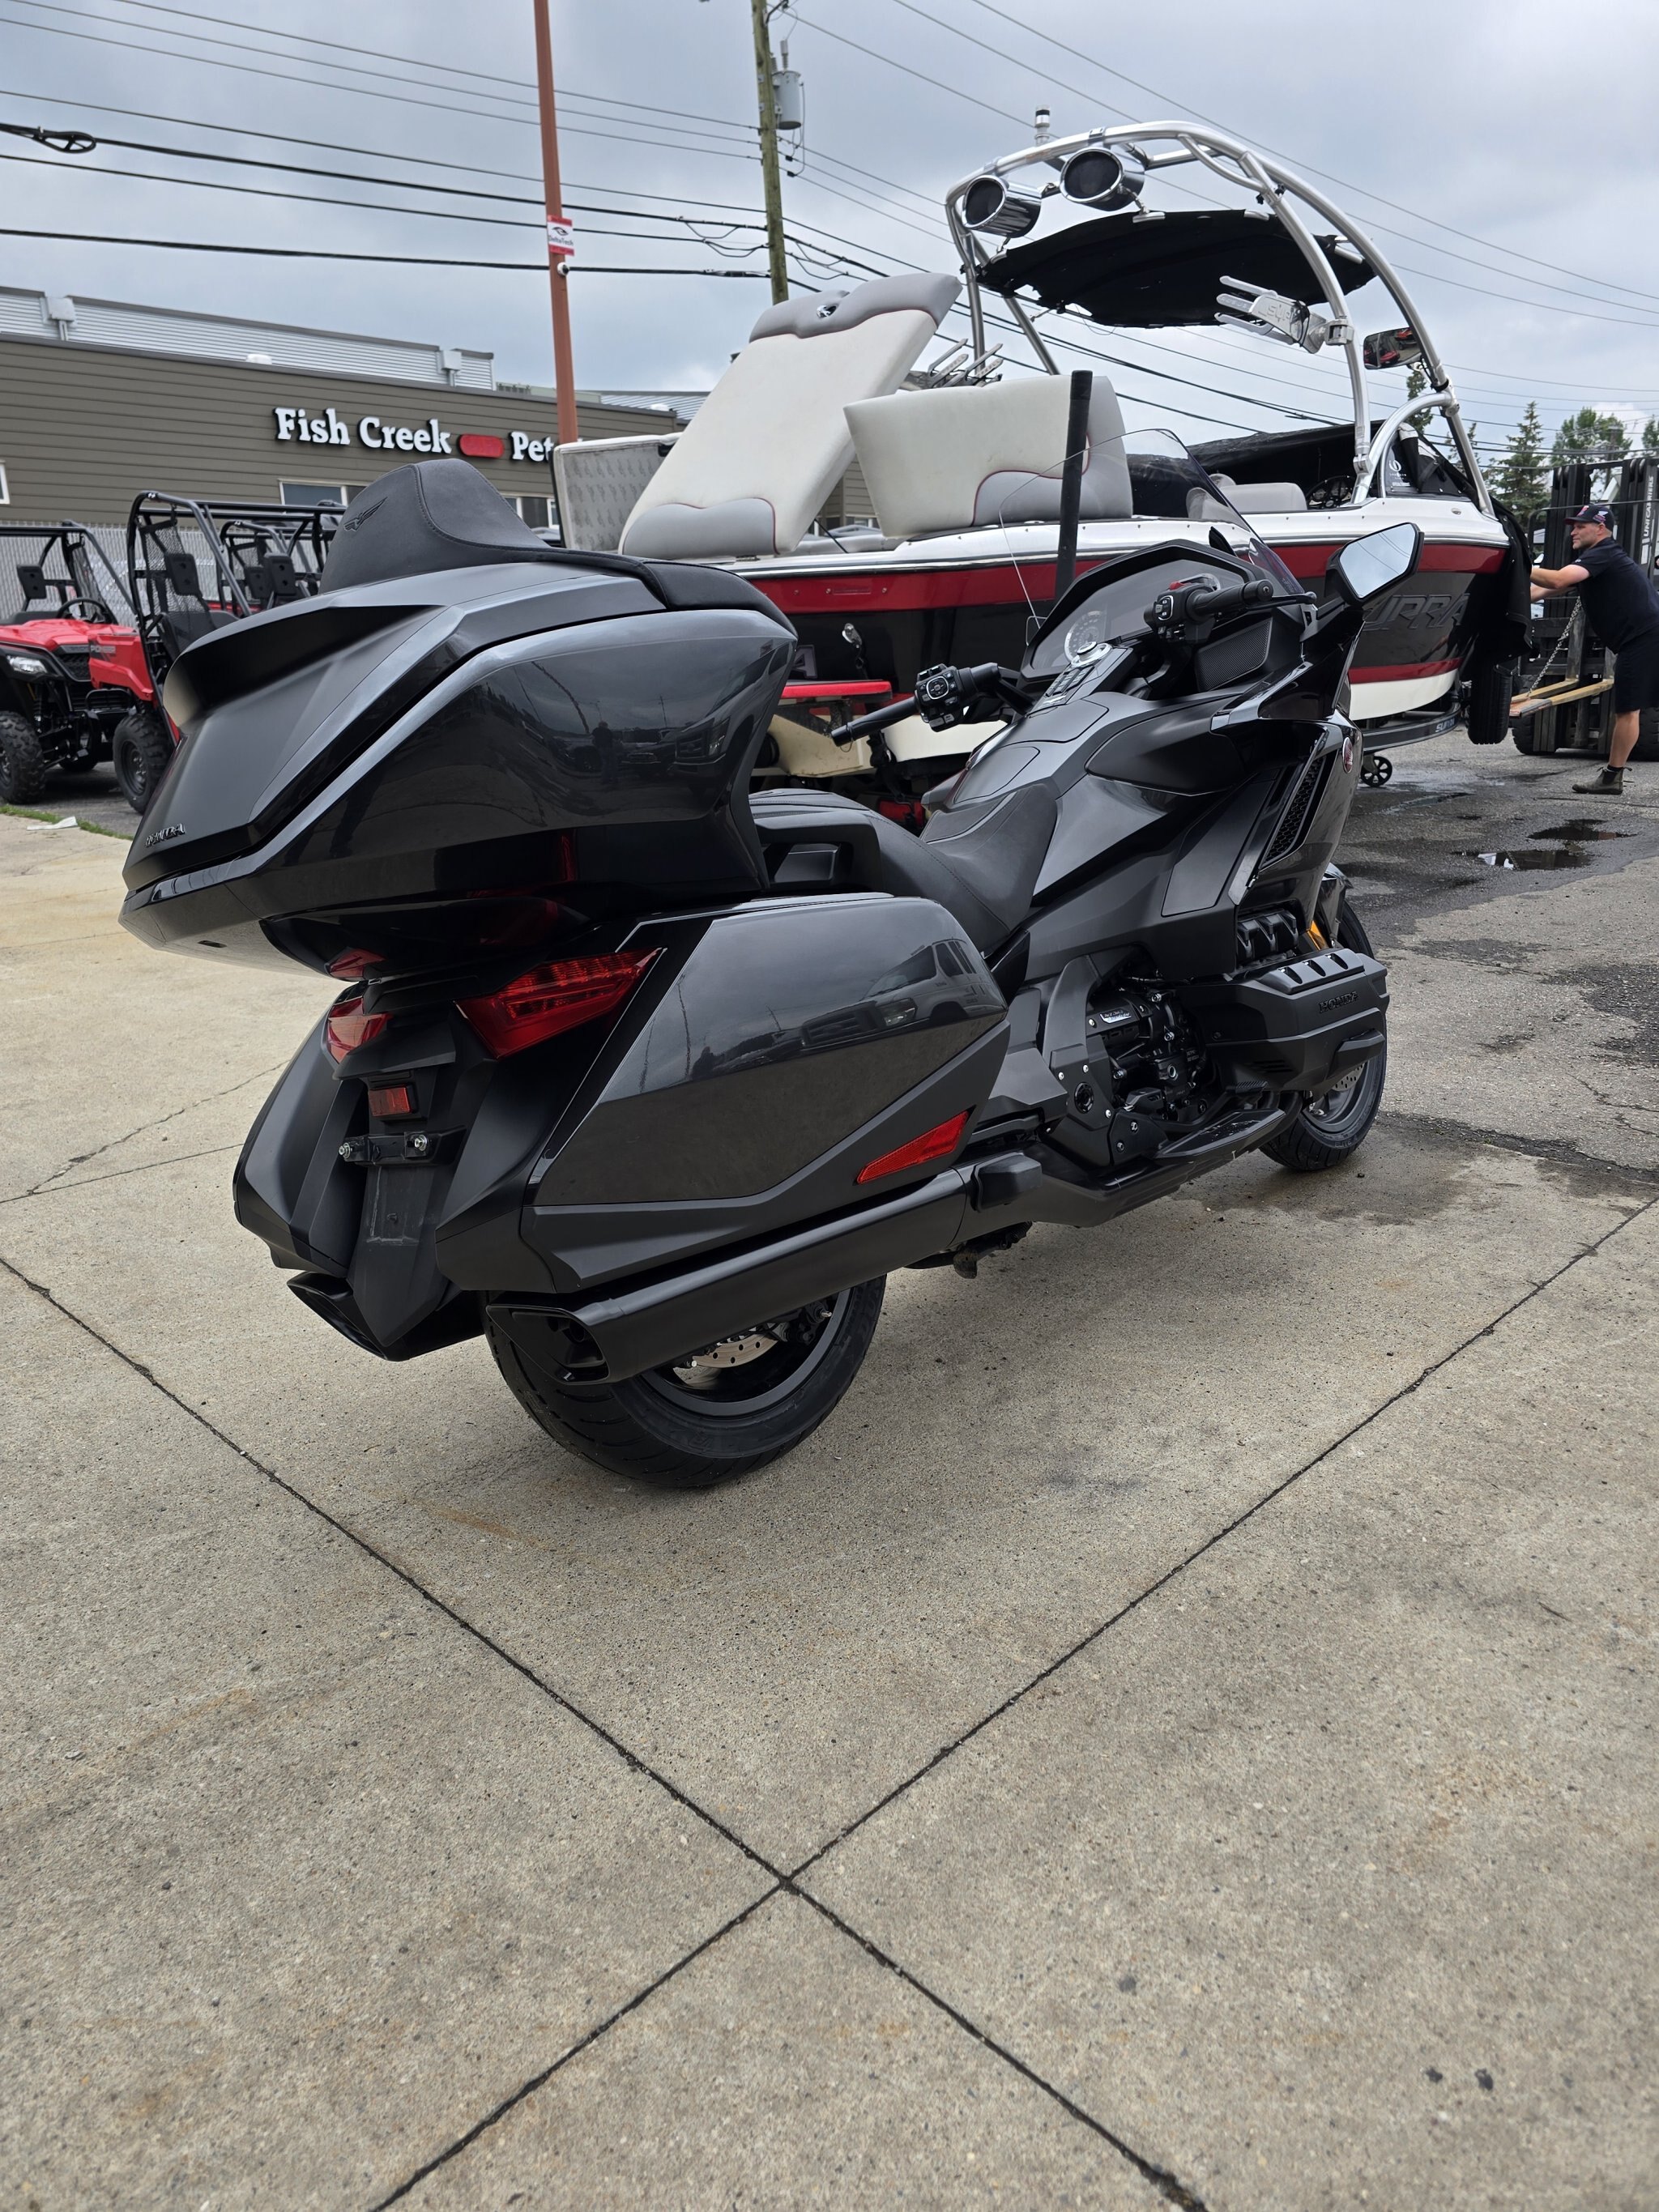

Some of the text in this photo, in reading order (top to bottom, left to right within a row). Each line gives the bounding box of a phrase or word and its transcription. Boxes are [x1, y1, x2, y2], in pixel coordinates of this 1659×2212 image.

[275, 407, 351, 445] Fish
[359, 417, 453, 454] Creek
[1643, 475, 1654, 538] UNICARRIERS
[146, 822, 186, 848] HONDA
[1318, 991, 1359, 1014] HONDA
